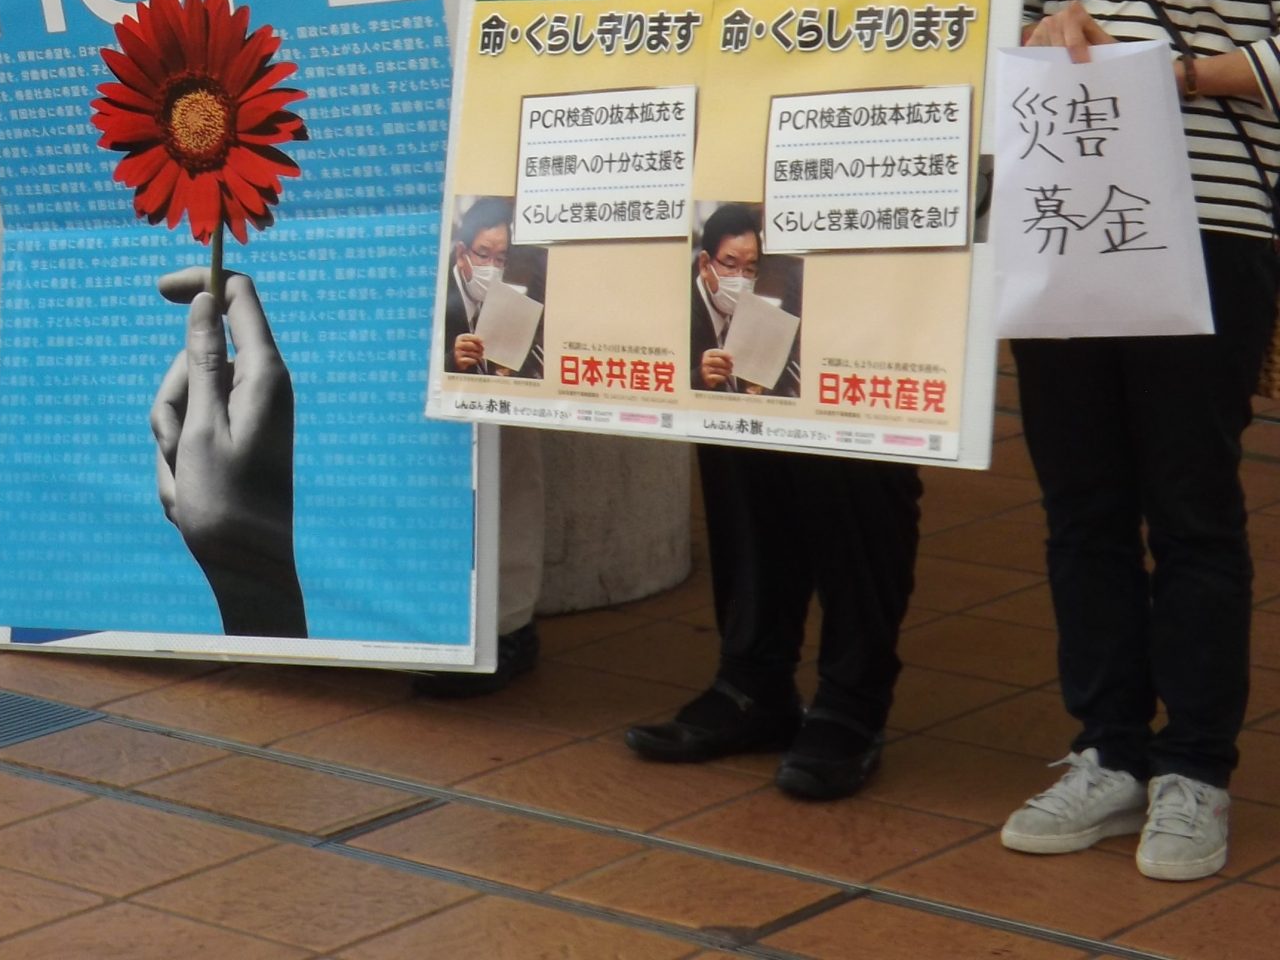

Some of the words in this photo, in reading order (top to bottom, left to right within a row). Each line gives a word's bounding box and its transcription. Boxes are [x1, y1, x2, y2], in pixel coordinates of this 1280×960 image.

[479, 10, 703, 56] 命・くらし守ります
[720, 4, 976, 53] 命・くらし守ります
[529, 100, 686, 130] PCR検査の抜本拡充を
[778, 101, 960, 131] PCR検査の抜本拡充を
[1012, 83, 1120, 163] 災害
[525, 149, 685, 178] 医療機関への十分な支援を
[773, 153, 960, 182] 医療機関への十分な支援を
[522, 199, 685, 225] くらしと営業の補償を急げ
[772, 206, 960, 232] くらしと営業の補償を急げ
[1023, 184, 1168, 255] 募金
[560, 355, 675, 393] 日本共産党
[818, 372, 947, 414] 日本共産党
